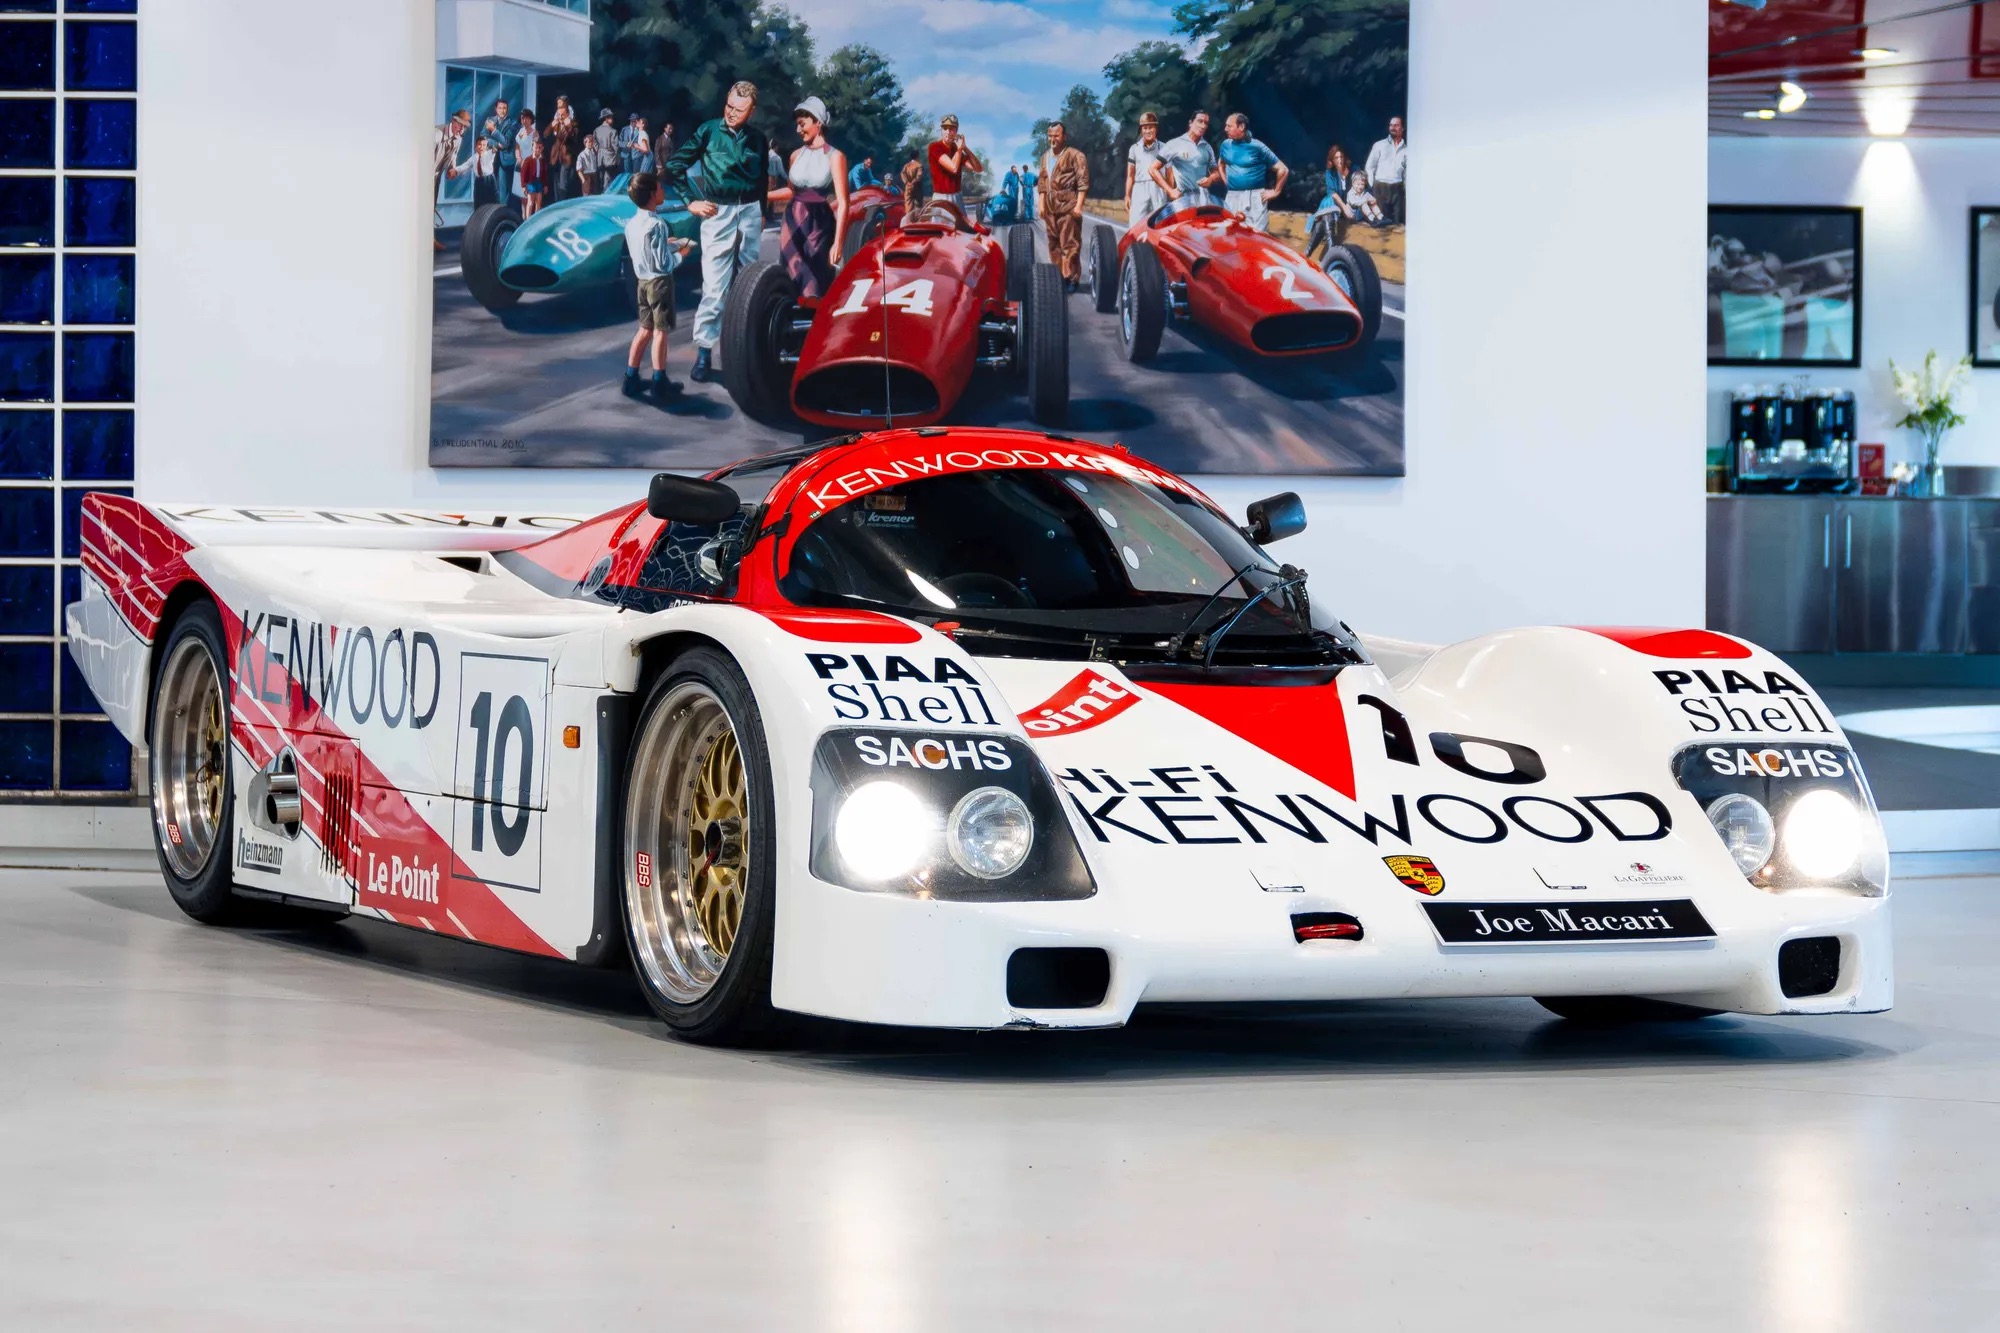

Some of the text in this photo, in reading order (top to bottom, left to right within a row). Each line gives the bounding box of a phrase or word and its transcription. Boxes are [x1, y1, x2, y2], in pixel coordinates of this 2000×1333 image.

[546, 228, 593, 260] 18
[832, 278, 934, 317] 14
[1262, 266, 1314, 299] 2
[807, 450, 1049, 509] KENWOOD
[868, 511, 915, 523] kremer
[236, 610, 441, 729] KENWOOD
[804, 653, 982, 686] PIAA
[1652, 669, 1809, 696] PIAA
[827, 683, 1002, 725] Shell
[1023, 679, 1129, 732] oint
[1680, 696, 1834, 733] Shell
[854, 735, 1012, 770] SACHS
[1357, 693, 1547, 785] 10
[470, 691, 534, 857] 10
[1706, 747, 1845, 778] SACHS
[168, 824, 181, 843] BBS
[1067, 792, 1672, 846] KENWOOD
[237, 827, 282, 870] heinzmann
[367, 852, 440, 904] Le Point
[638, 853, 650, 886] BBS
[1469, 908, 1674, 935] Joe Macari
